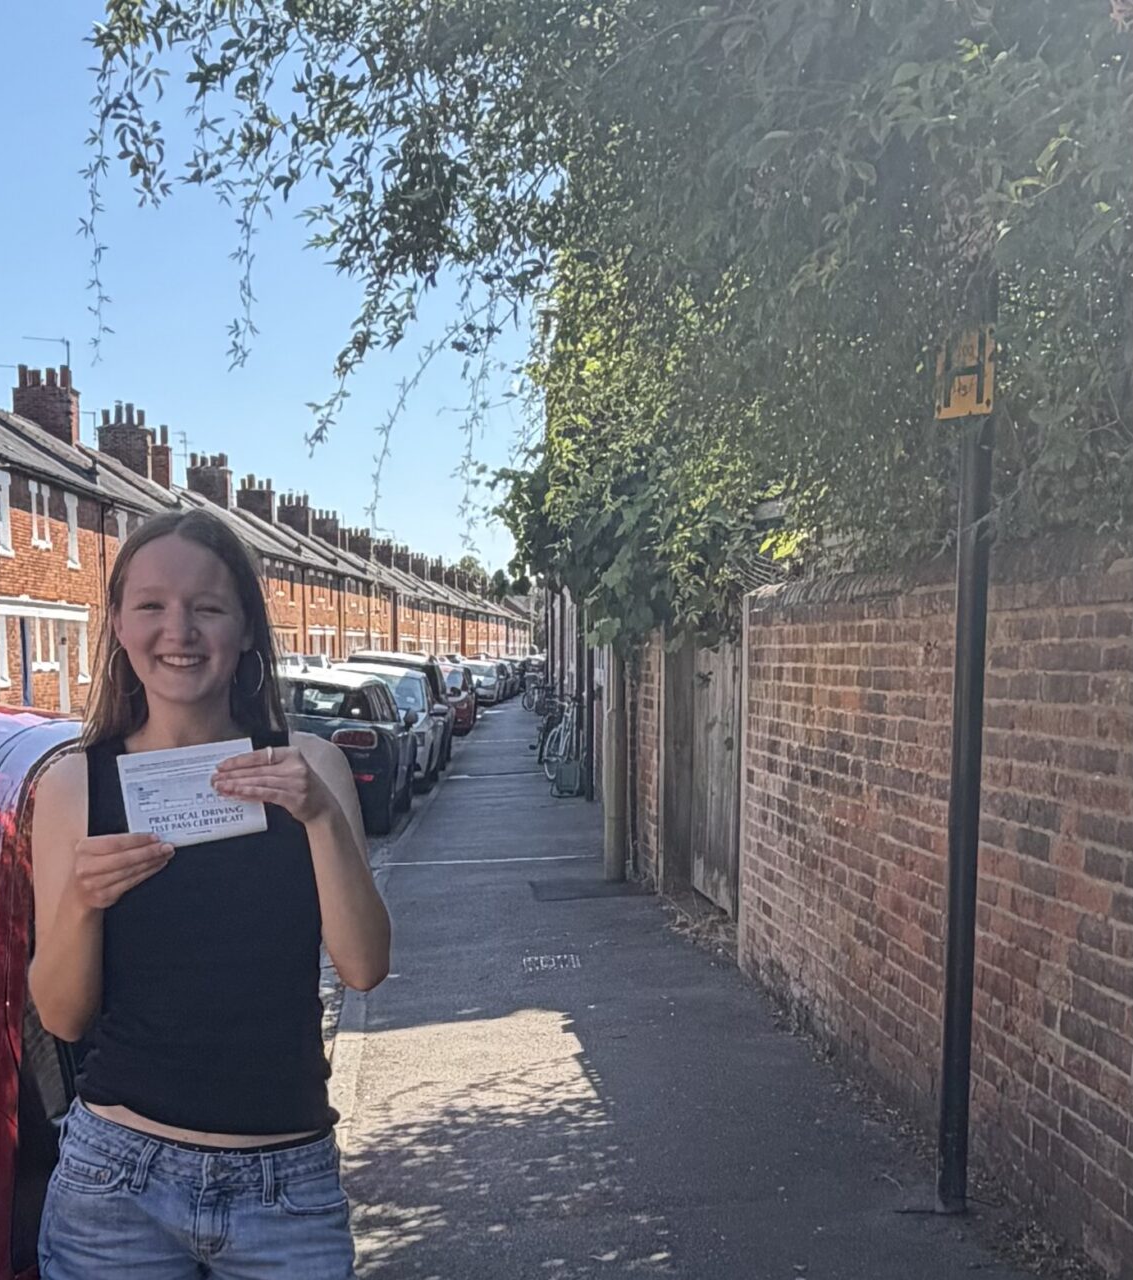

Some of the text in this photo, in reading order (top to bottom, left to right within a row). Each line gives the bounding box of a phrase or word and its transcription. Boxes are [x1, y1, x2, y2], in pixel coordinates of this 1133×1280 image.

[148, 805, 244, 825] PRACTICAL DRIVING
[151, 813, 244, 834] TEST PASS CERTIFICATE
